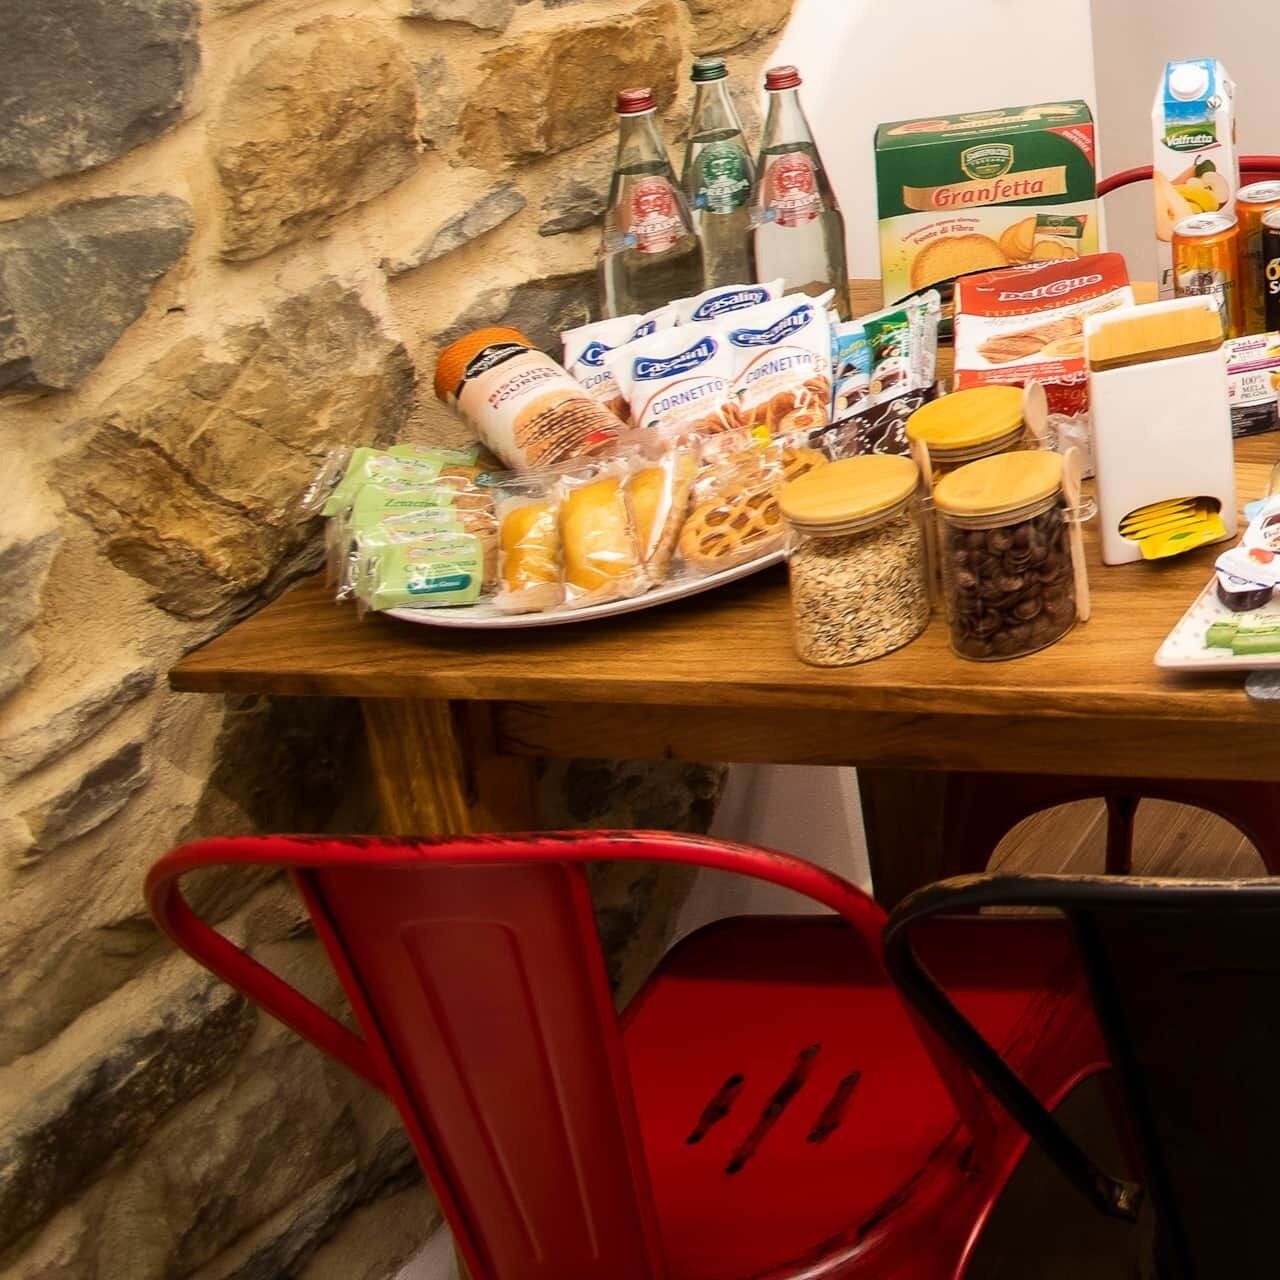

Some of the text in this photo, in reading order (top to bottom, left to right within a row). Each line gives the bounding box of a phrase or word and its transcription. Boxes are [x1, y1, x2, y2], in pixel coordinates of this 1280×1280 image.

[1166, 133, 1213, 147] Valfrutta
[934, 179, 1044, 207] Granfetta
[950, 224, 975, 232] Fibra
[699, 291, 763, 317] Casalini
[745, 352, 812, 384] CORNETTO
[651, 379, 723, 415] CORNETTO
[1242, 383, 1265, 393] MELA
